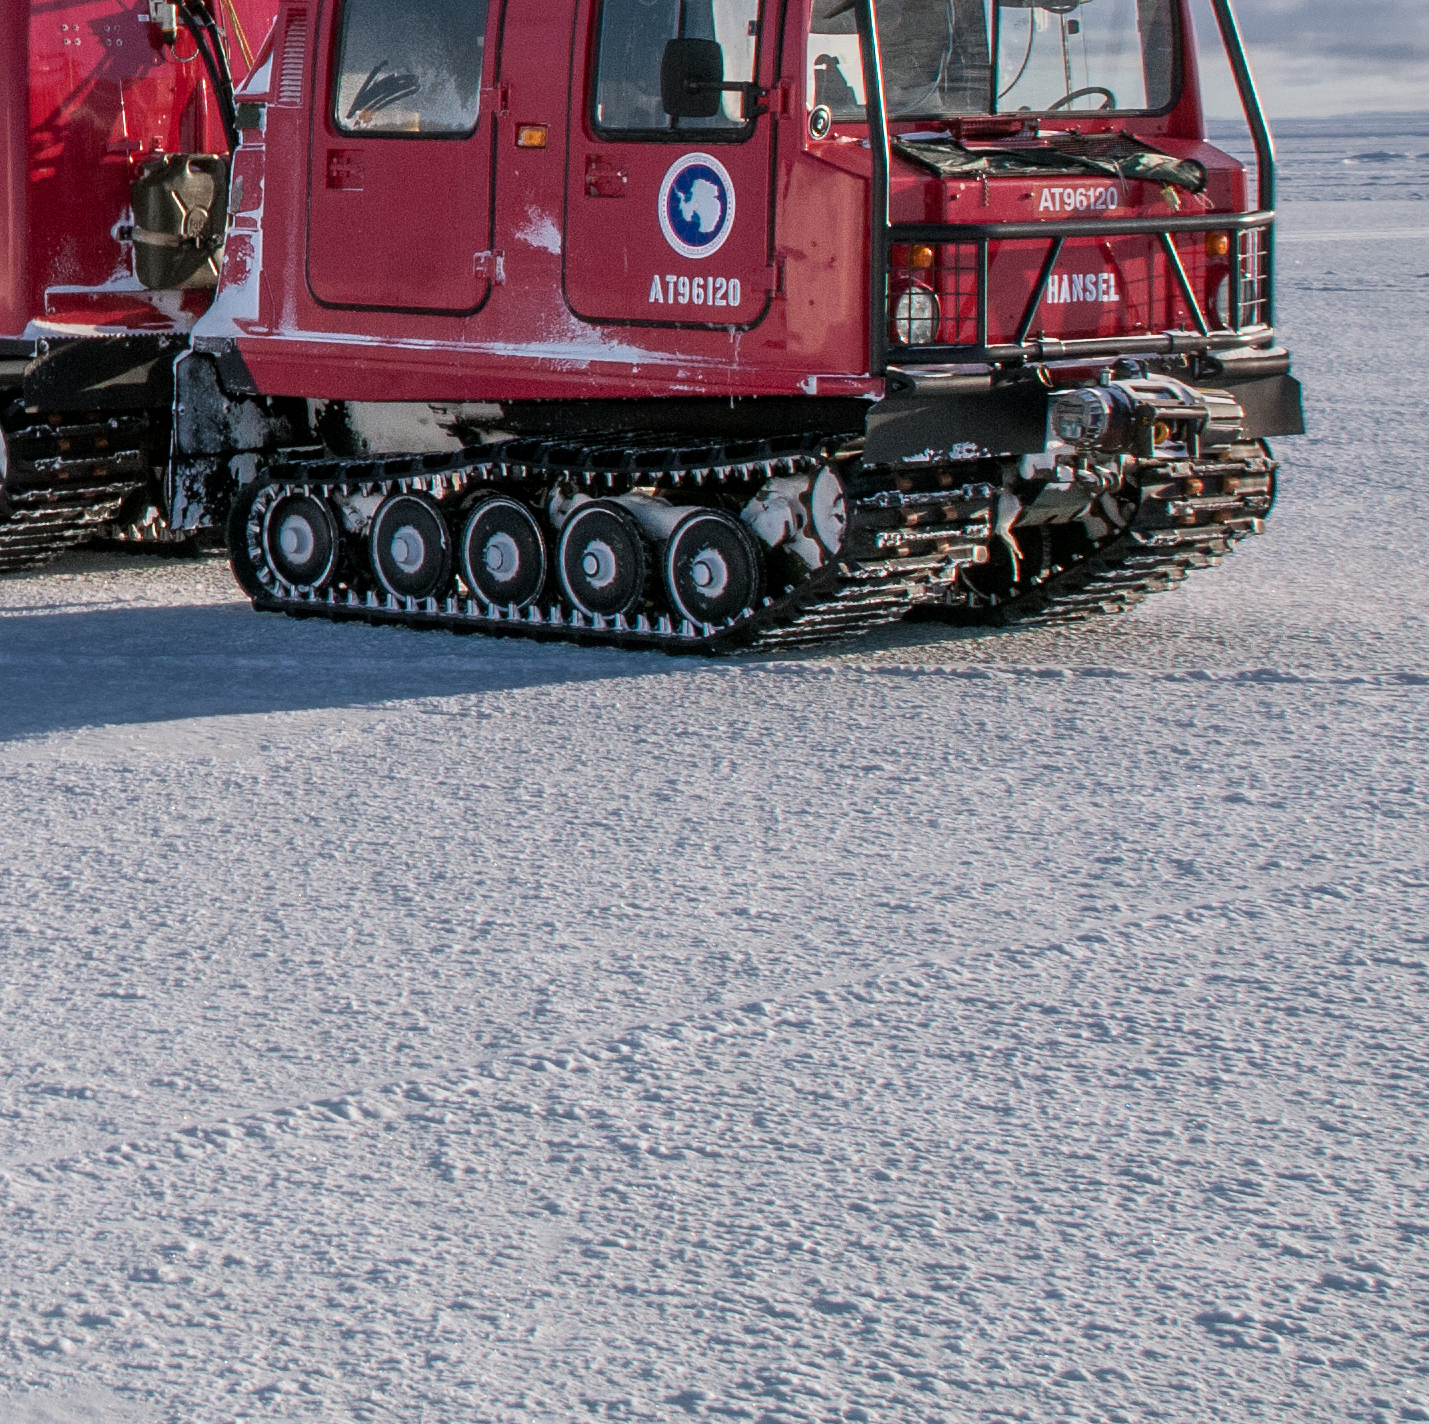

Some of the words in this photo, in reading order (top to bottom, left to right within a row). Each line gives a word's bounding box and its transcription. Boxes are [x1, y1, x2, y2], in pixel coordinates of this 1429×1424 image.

[1039, 187, 1118, 211] AT96120
[649, 275, 741, 306] AT96120
[1046, 273, 1119, 304] HANSEL
